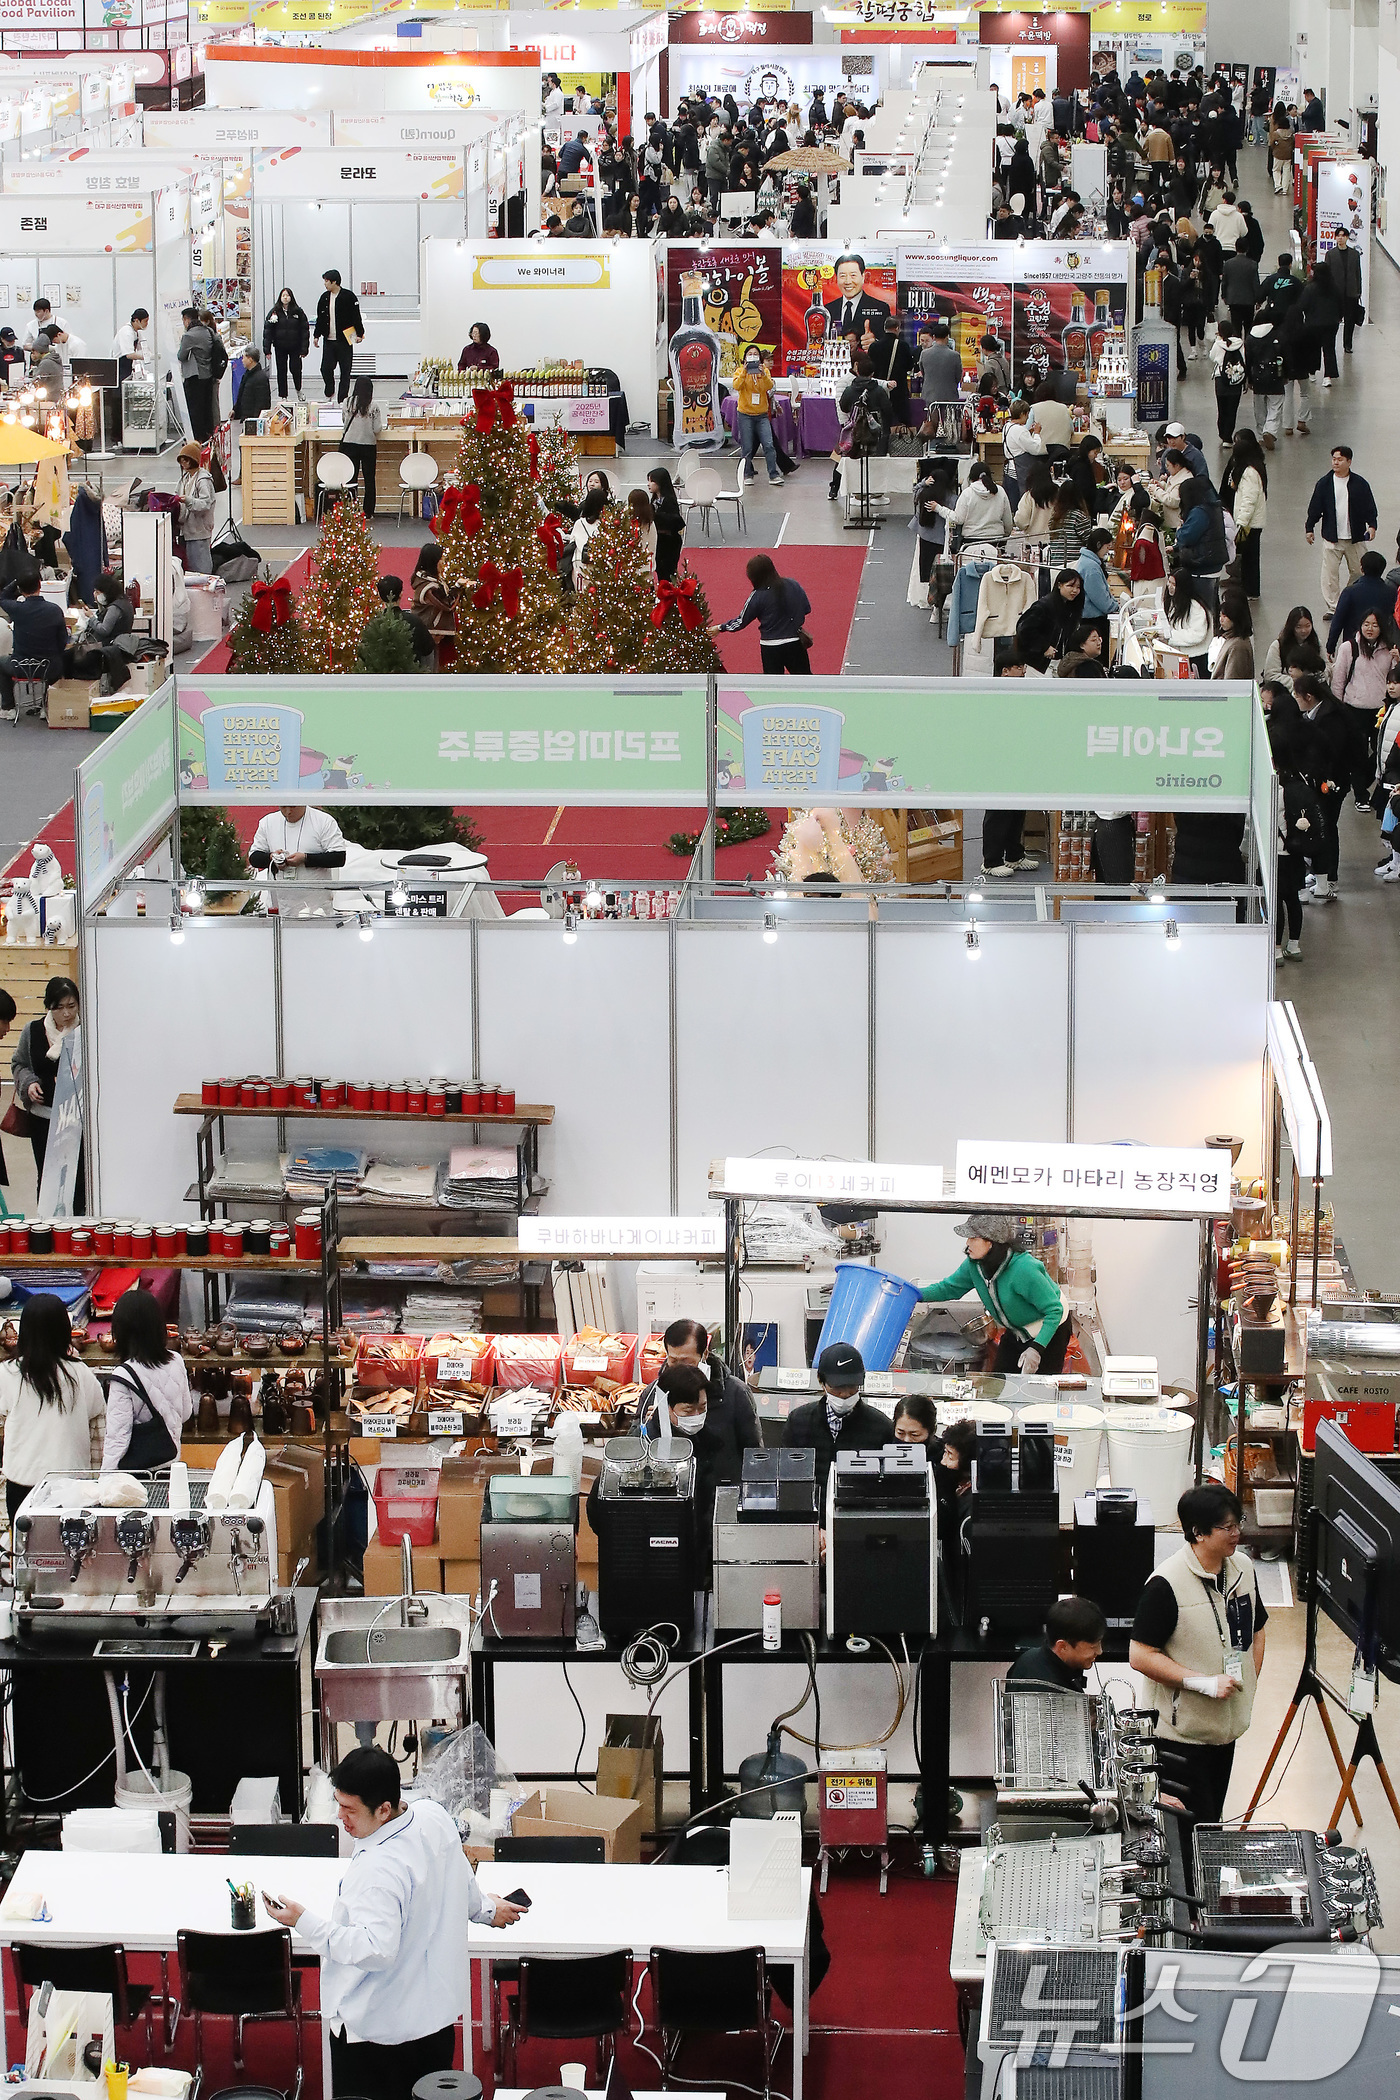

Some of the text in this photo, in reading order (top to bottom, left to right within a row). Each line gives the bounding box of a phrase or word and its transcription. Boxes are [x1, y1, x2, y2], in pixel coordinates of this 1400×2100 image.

[0, 8, 76, 18] ood Pavilion
[856, 0, 937, 22] 찰떡궁합
[340, 167, 377, 179] 문라또
[20, 217, 48, 231] 존잼
[193, 249, 202, 267] 507
[905, 254, 999, 263] www.soosungliquor.com
[517, 268, 566, 276] We 와이너리
[1023, 272, 1052, 280] Since1957
[1052, 272, 1076, 280] 대한민국
[1076, 272, 1093, 280] 고량주
[908, 291, 936, 308] BLUE
[163, 300, 190, 310] MILK JAM
[913, 308, 929, 321] 35
[387, 894, 445, 905] 크스마스 트리
[394, 907, 437, 917] 렌탈 & 판매
[968, 1164, 1220, 1198] 예멘모카 마타리 농장직영
[1338, 1386, 1390, 1395] CAFE ROSTO
[830, 1778, 873, 1787] 전기 위험
